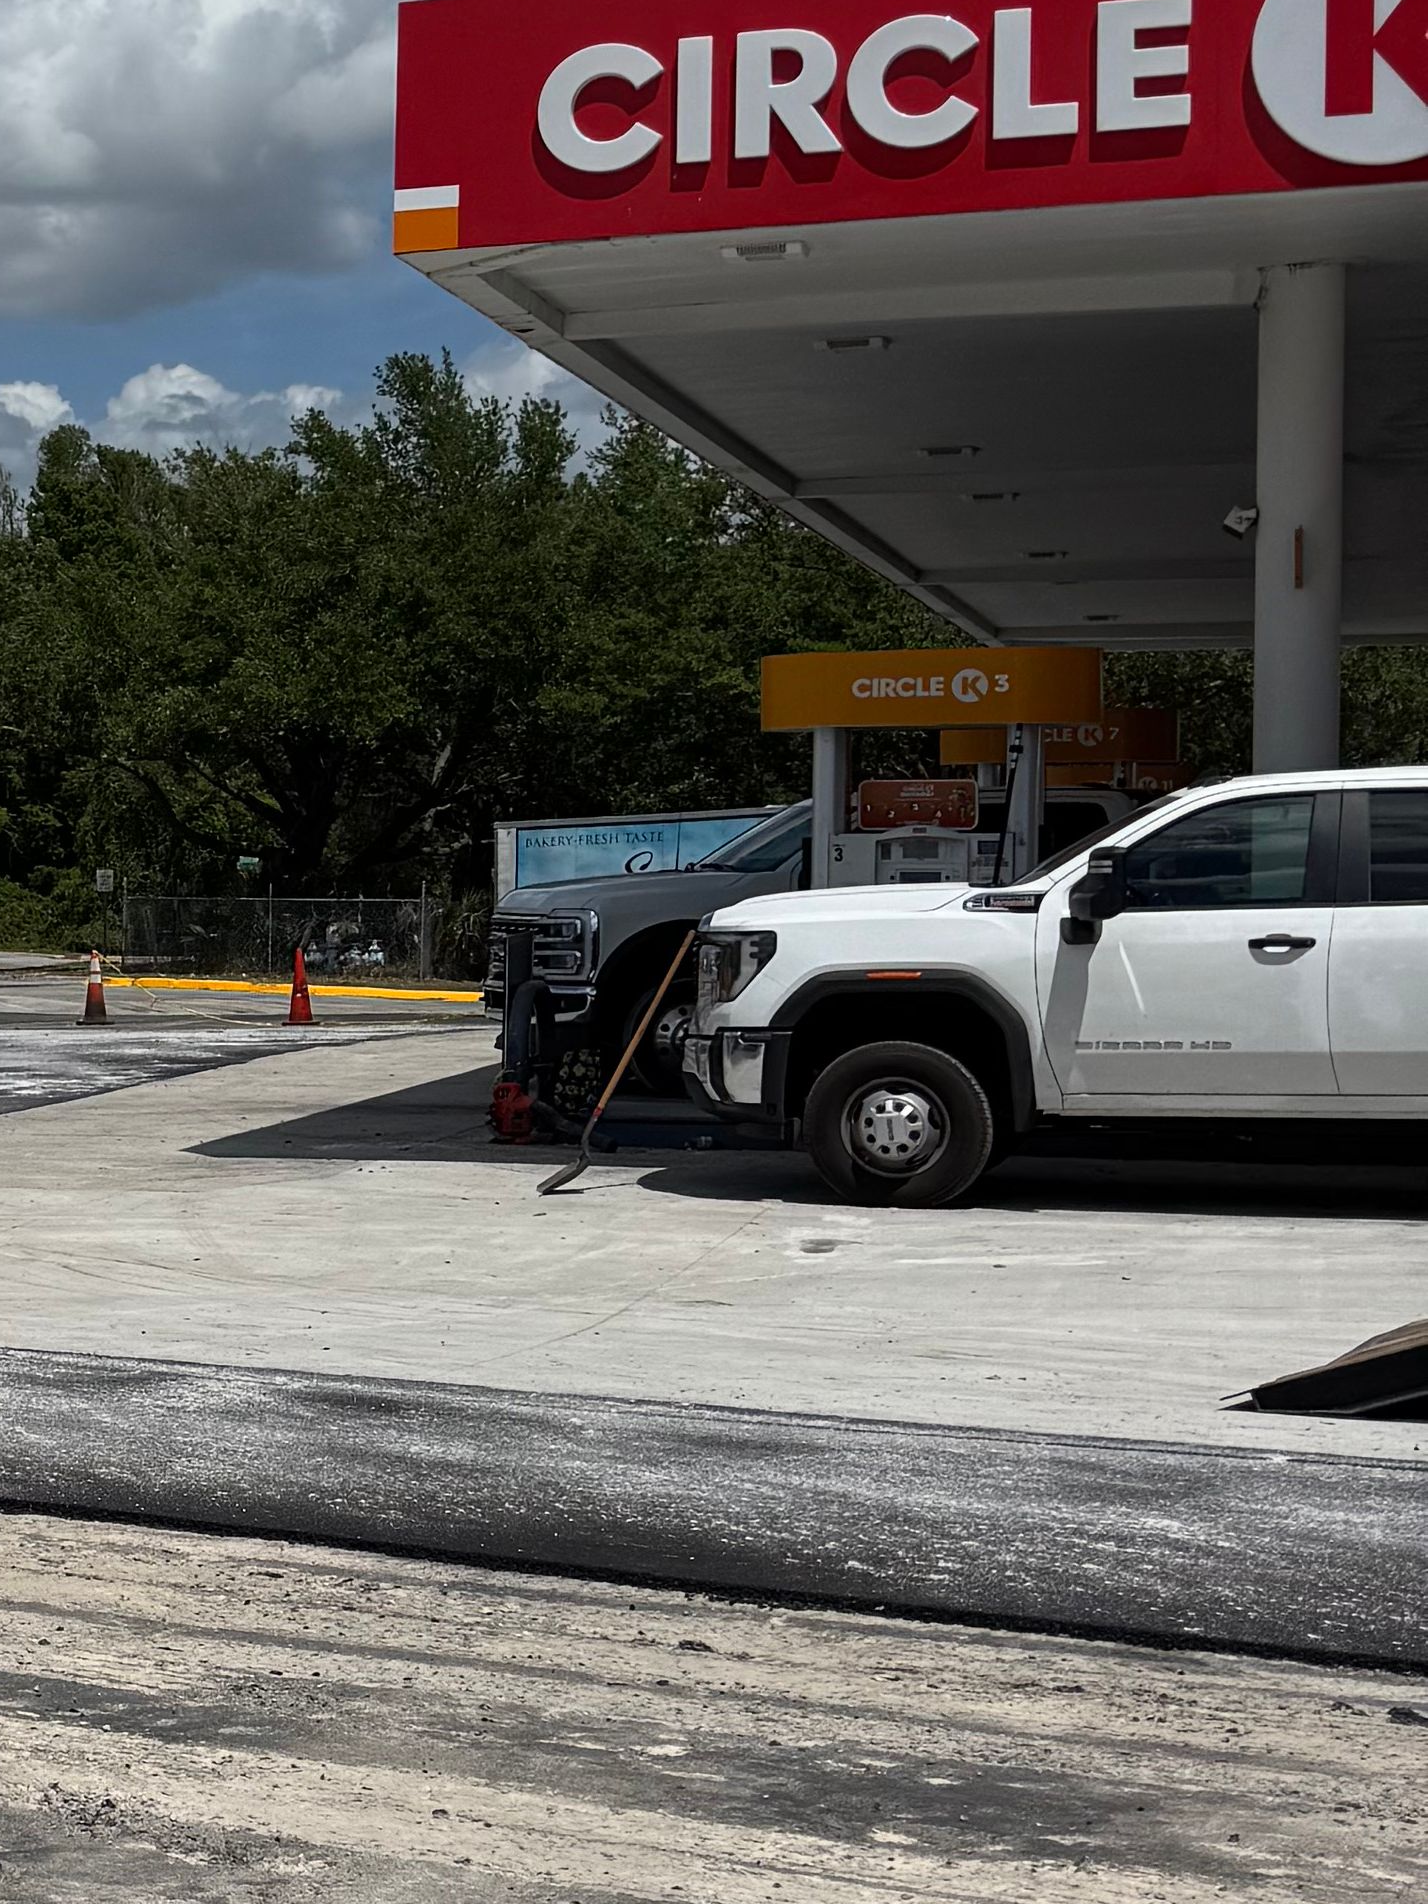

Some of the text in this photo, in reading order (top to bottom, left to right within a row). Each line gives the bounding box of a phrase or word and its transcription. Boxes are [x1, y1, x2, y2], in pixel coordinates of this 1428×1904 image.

[851, 676, 945, 698] CIRCLE
[994, 674, 1010, 692] 3
[1109, 727, 1120, 740] 7
[525, 830, 665, 848] BAKERY-FRESH TASTE
[833, 847, 844, 863] 3
